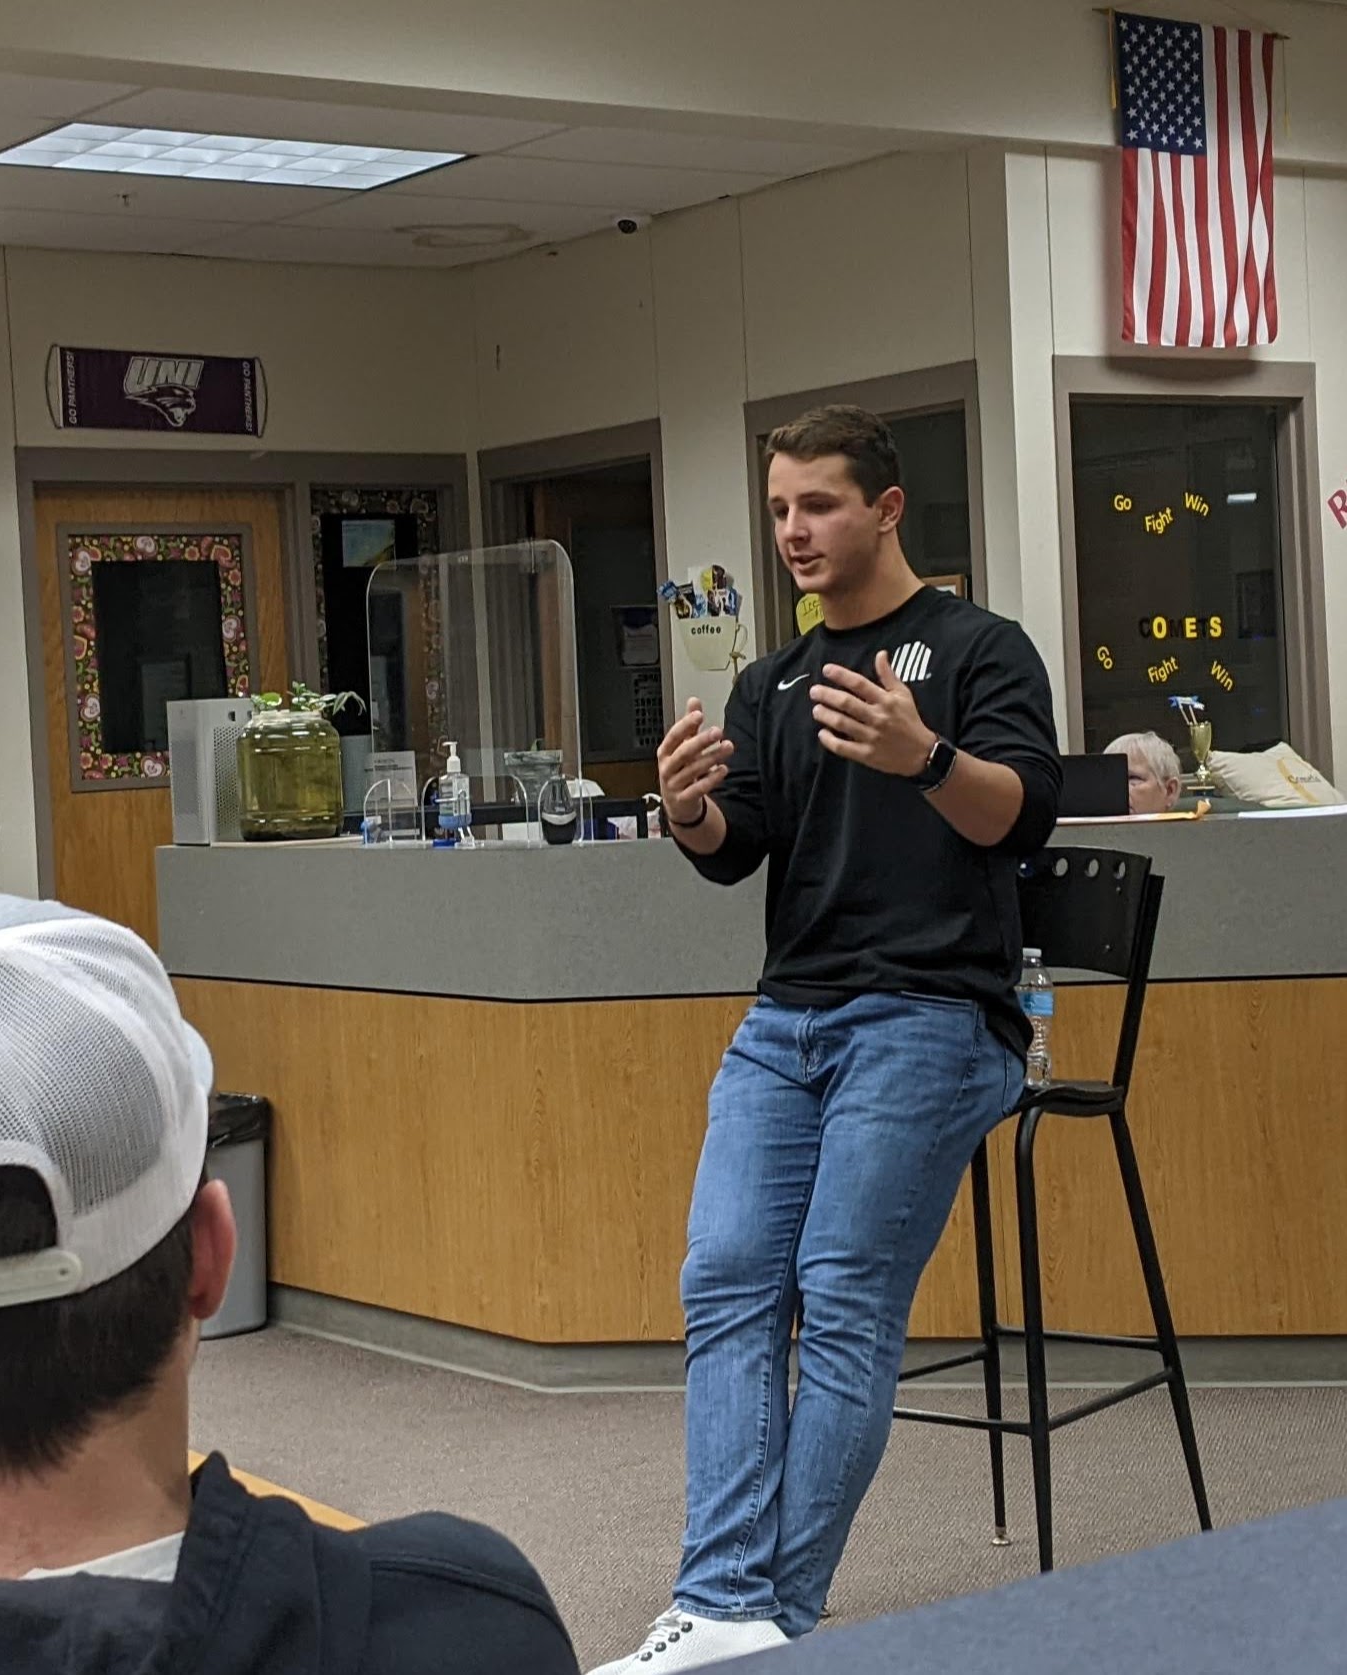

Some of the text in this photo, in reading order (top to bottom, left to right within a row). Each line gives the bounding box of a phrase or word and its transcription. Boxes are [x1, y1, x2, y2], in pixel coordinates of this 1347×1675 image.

[123, 356, 205, 395] UNI
[1114, 491, 1211, 534] Go Fight Win
[691, 624, 722, 635] coffee
[1097, 646, 1235, 692] Go Fight Win
